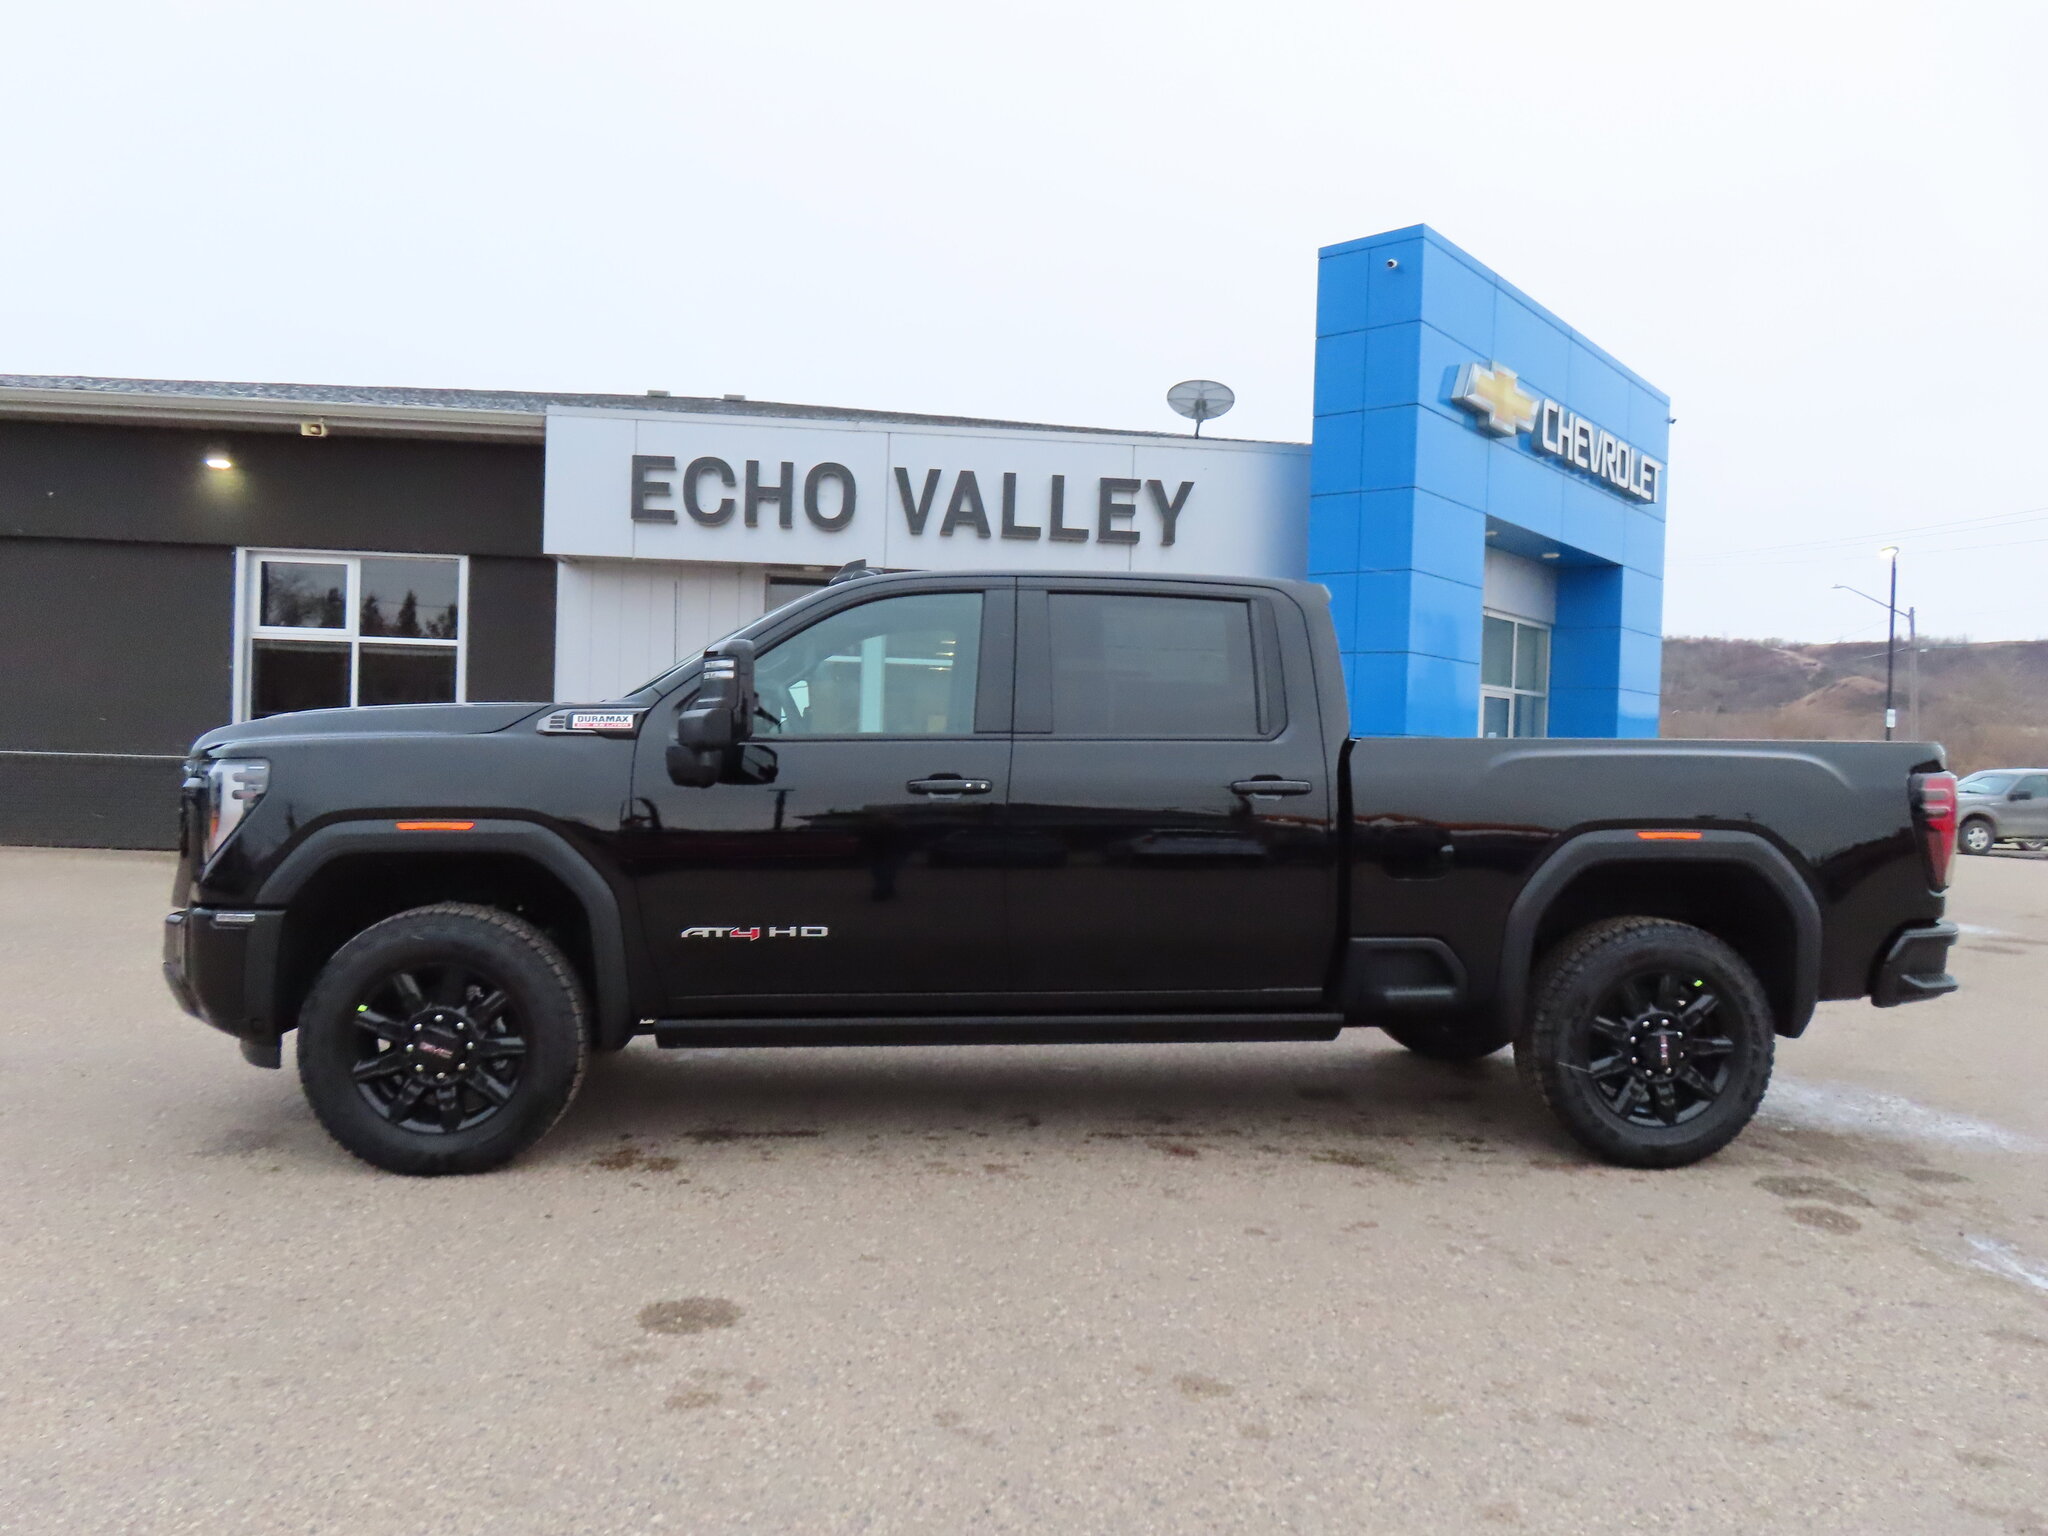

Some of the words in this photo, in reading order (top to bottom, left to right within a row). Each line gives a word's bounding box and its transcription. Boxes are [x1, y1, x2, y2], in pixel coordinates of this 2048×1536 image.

[1542, 398, 1663, 503] CHEVROLET
[631, 454, 857, 532] ECHO
[894, 466, 1195, 547] VALLEY
[577, 715, 629, 723] DURAMAX
[681, 926, 761, 942] AT4
[768, 926, 829, 938] HD
